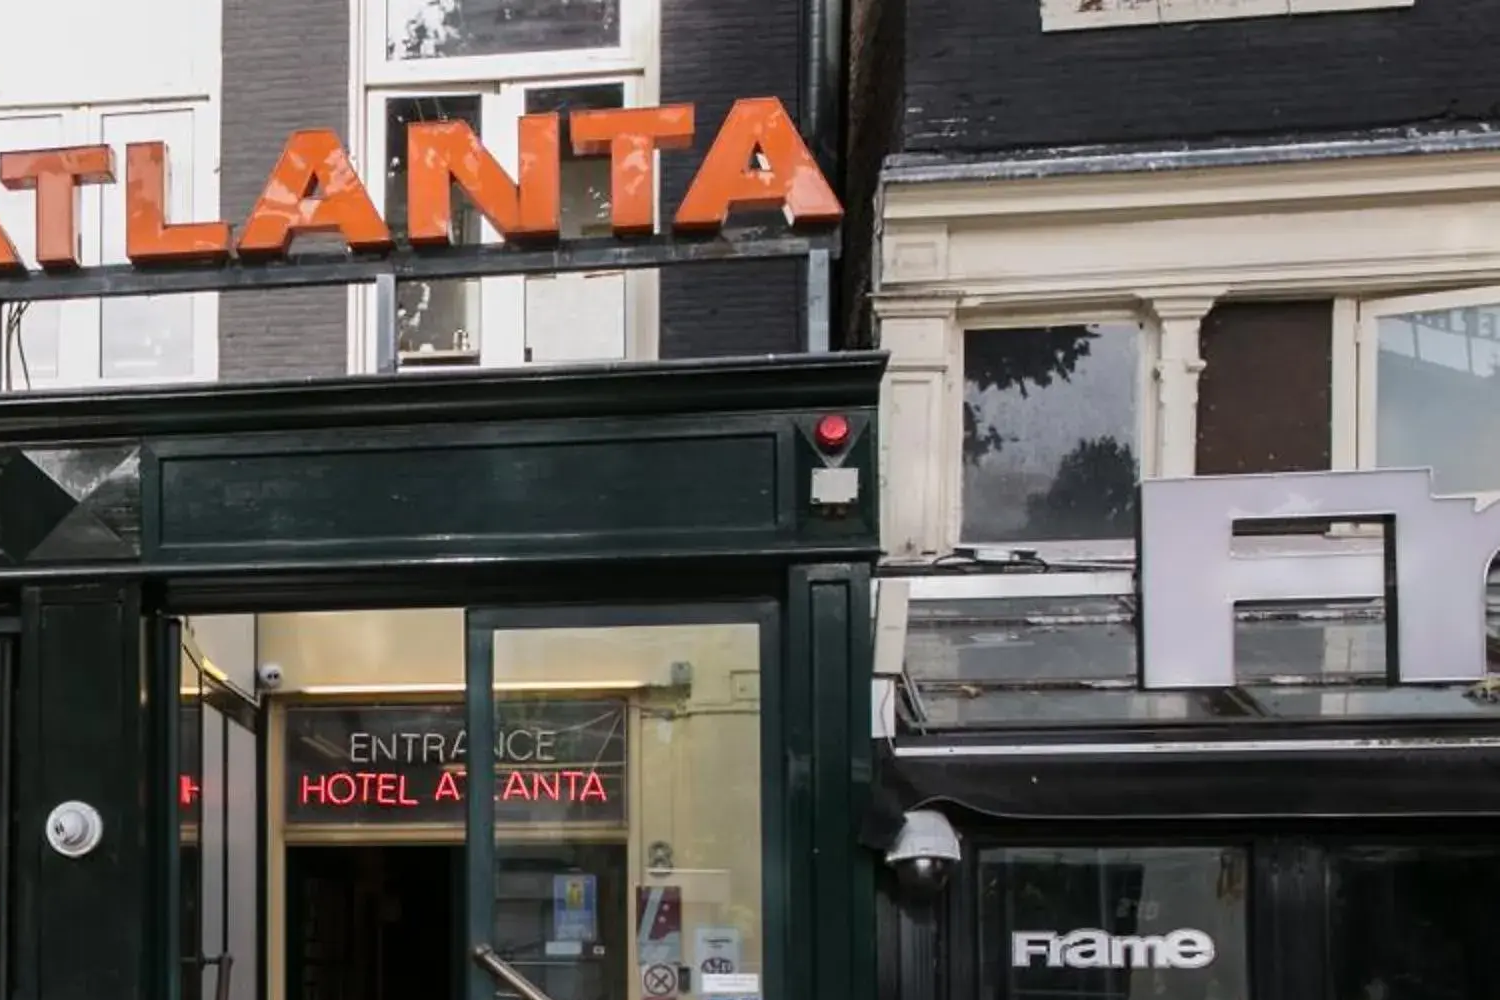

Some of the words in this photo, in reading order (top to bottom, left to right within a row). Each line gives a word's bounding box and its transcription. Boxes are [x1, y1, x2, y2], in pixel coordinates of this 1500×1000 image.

[302, 773, 419, 806] HOTEL
[434, 770, 607, 803] AANTA
[1012, 928, 1215, 968] Frame
